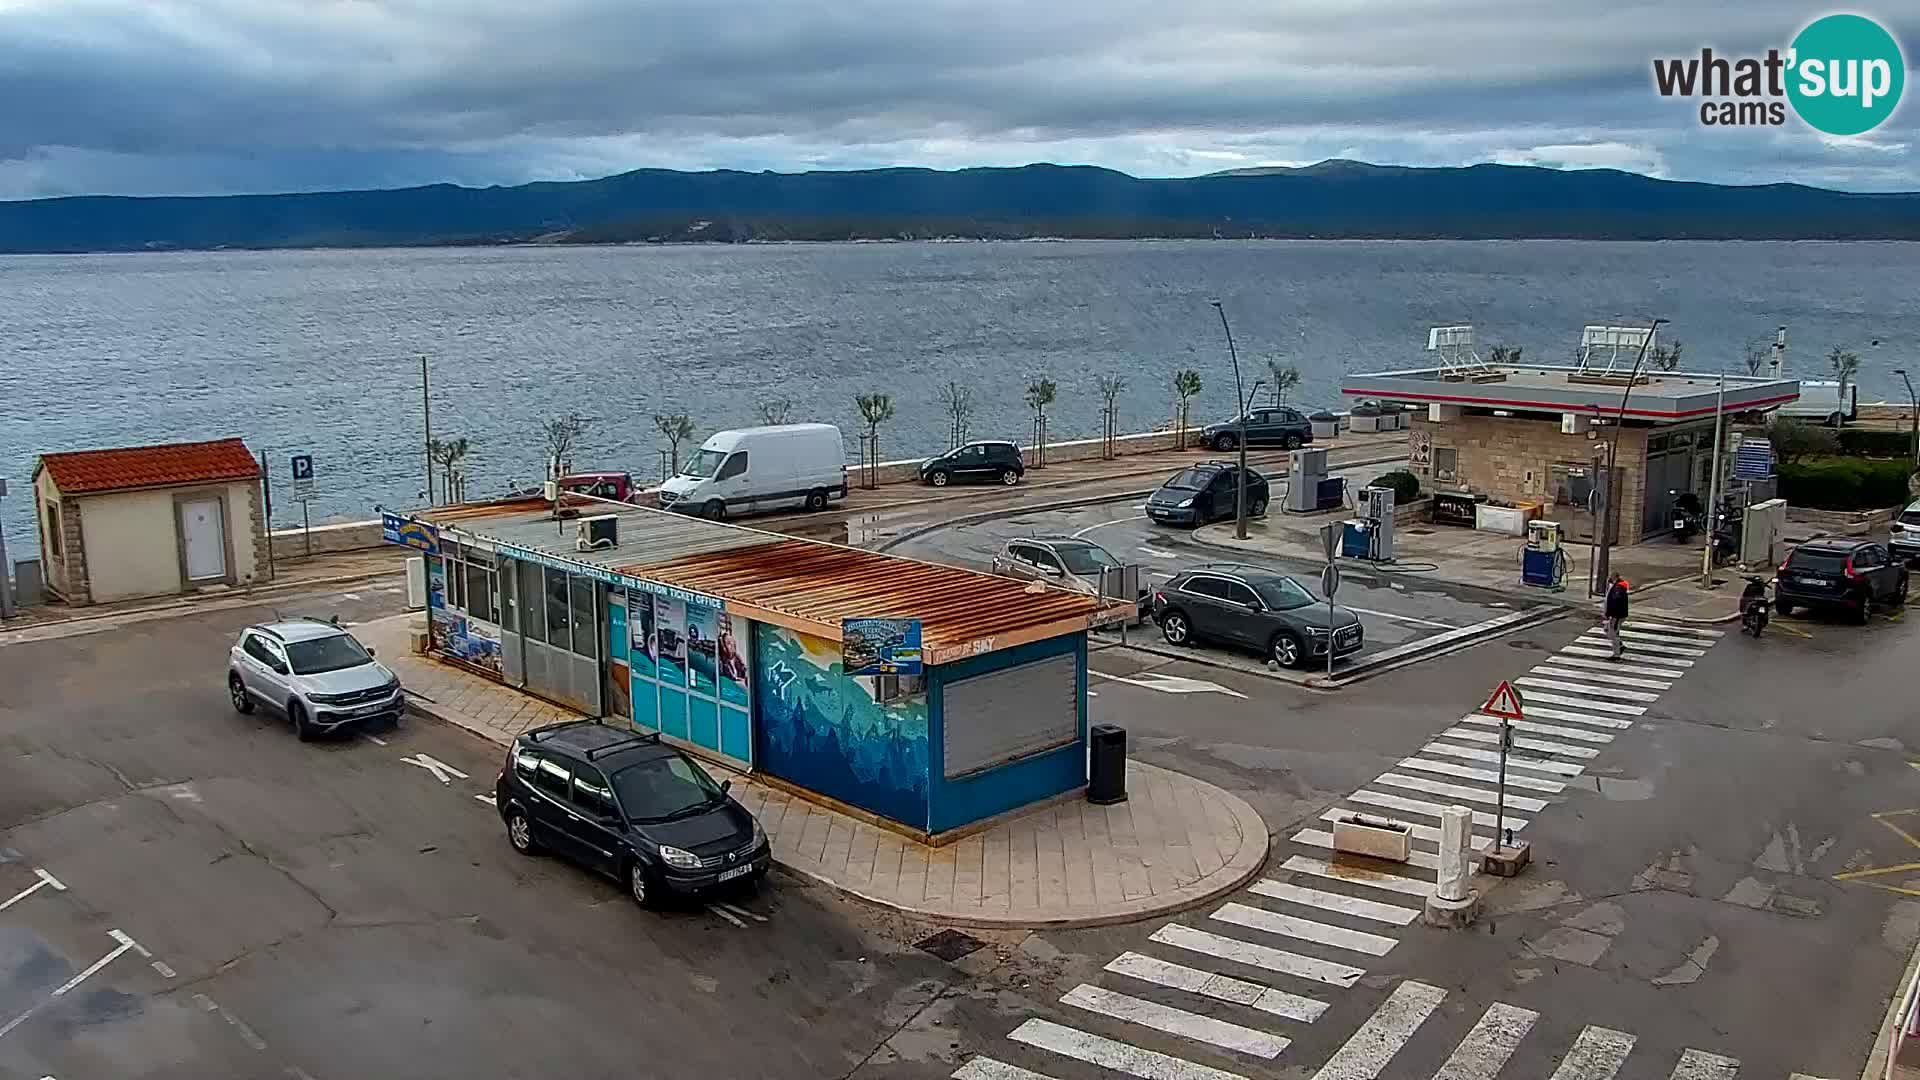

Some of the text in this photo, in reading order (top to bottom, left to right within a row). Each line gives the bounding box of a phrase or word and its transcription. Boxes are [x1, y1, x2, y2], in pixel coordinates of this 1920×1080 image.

[296, 459, 308, 476] P
[621, 577, 634, 588] BUS
[636, 581, 668, 595] STATION
[670, 589, 694, 602] TICKET
[696, 595, 721, 609] OFFICE
